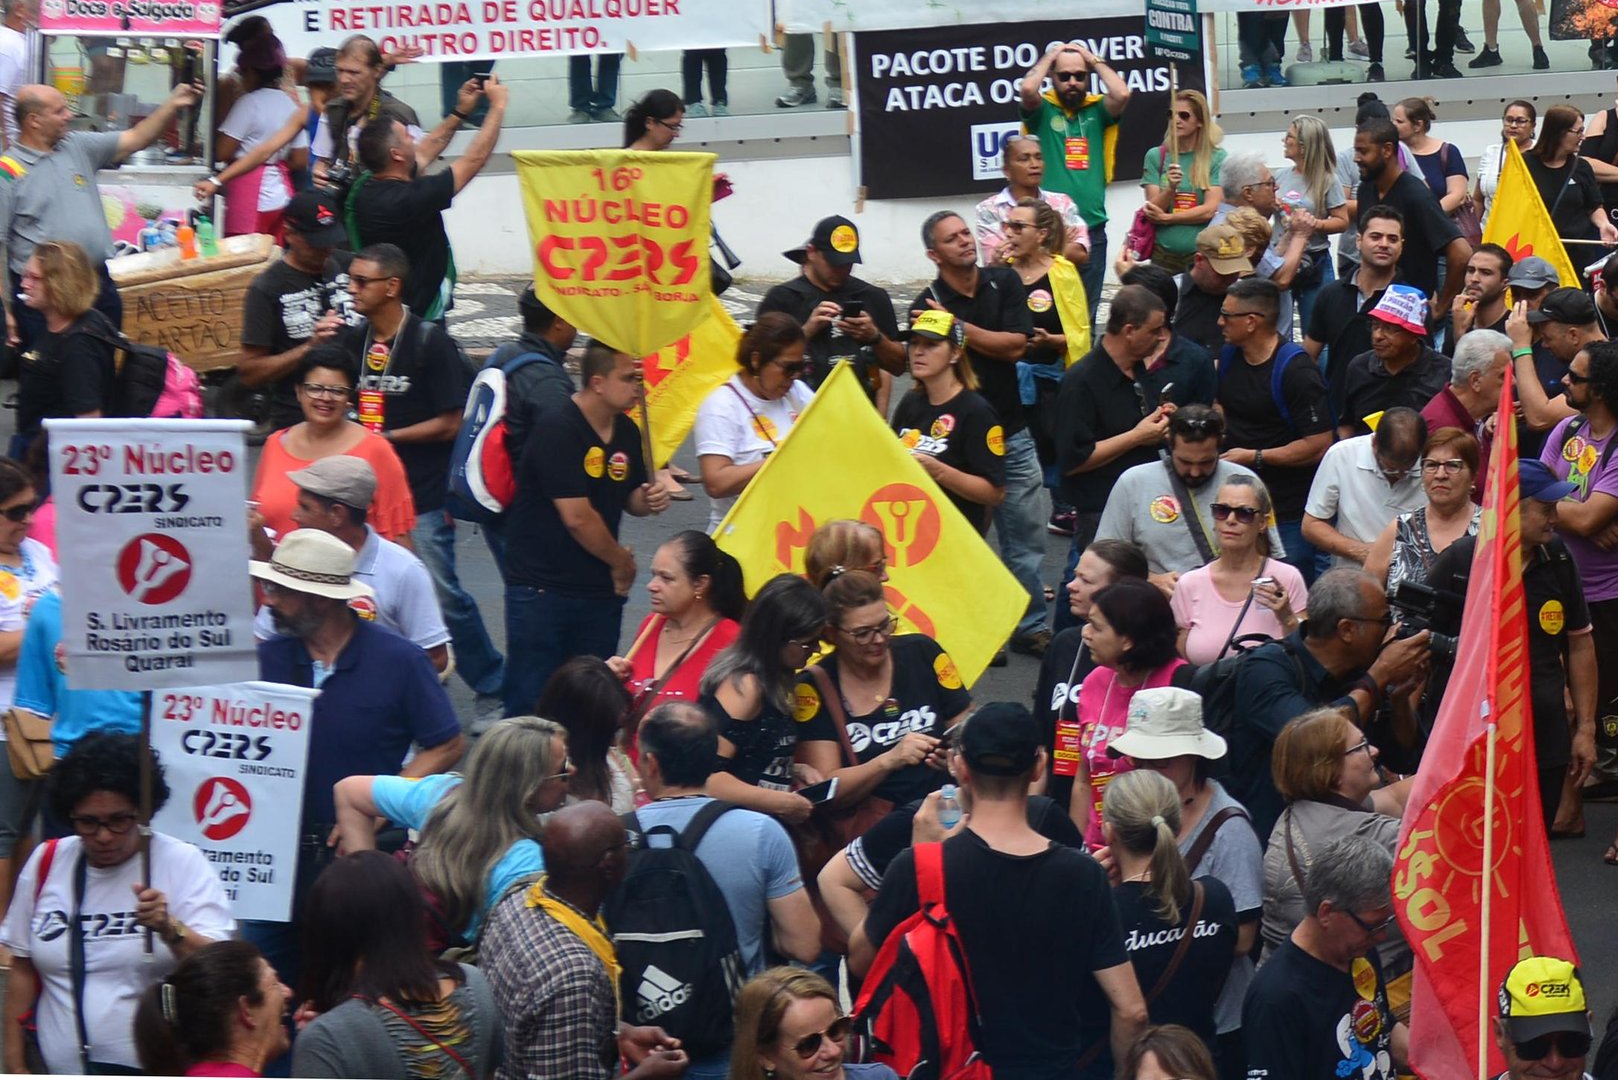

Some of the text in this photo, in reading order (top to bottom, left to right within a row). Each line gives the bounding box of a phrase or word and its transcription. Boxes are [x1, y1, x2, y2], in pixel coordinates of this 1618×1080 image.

[303, 9, 319, 33] E
[328, 2, 472, 31] RETIRADA
[484, 0, 519, 23] DE
[1148, 9, 1195, 31] CONTRA
[489, 25, 609, 55] DIREITO.
[871, 42, 1039, 79] PACOTE DO
[885, 78, 1024, 113] ATACA OS
[591, 167, 643, 192] 16º
[543, 193, 690, 229] NÚCLEO
[536, 233, 699, 286] CPERS
[61, 442, 236, 476] 23º Núcleo
[77, 483, 191, 514] CPERS
[154, 516, 224, 529] SINDICATO
[87, 609, 228, 631] S. Livramento
[86, 628, 232, 653] Rosário do Sul
[162, 694, 303, 732] 23º Núcleo
[182, 729, 273, 762] CPERS
[239, 763, 297, 779] SINDICATO
[219, 867, 274, 885] do Sul
